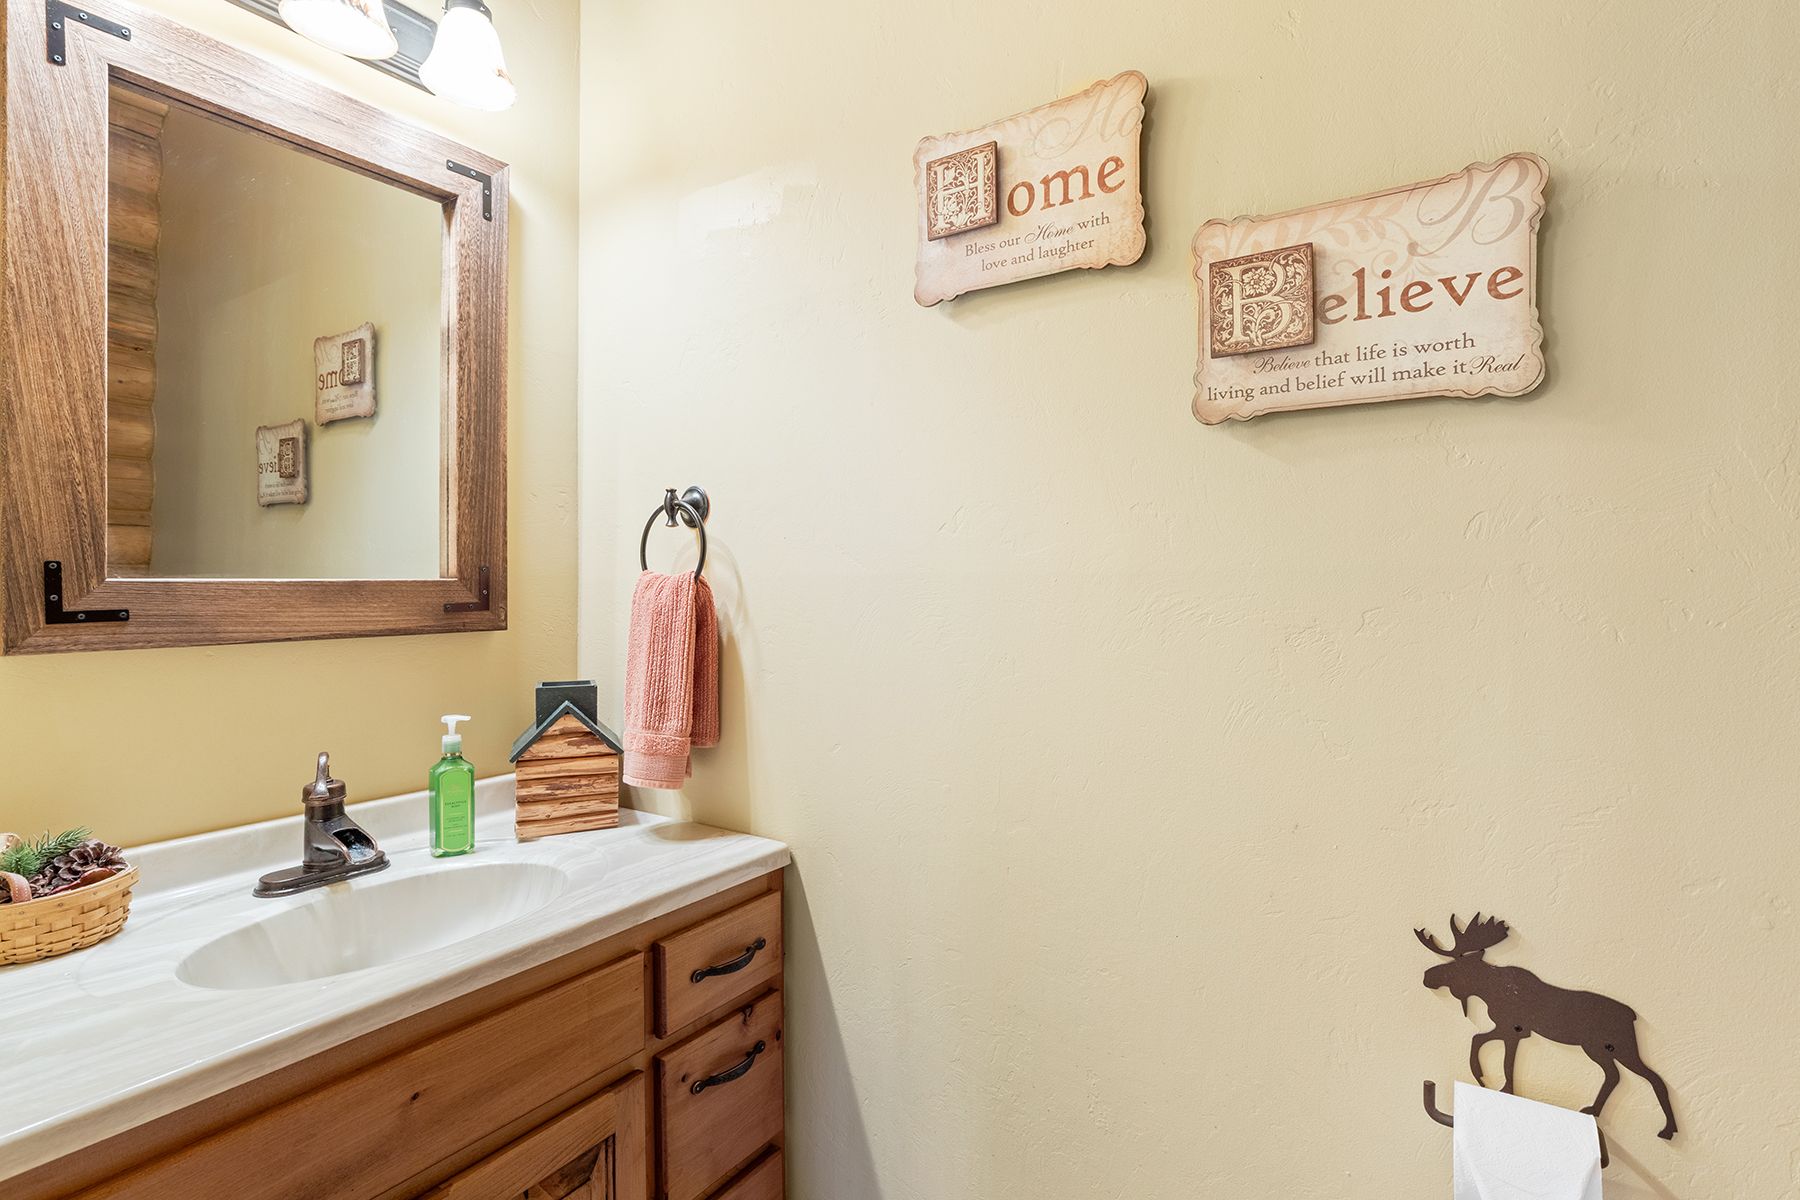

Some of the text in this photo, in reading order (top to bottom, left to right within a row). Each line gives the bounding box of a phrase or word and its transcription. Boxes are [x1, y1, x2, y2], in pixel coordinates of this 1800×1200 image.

[929, 150, 1126, 232] Home
[964, 211, 1110, 257] Bless our Home with
[981, 237, 1095, 272] love and laughter
[1215, 260, 1524, 346] Believe
[1252, 332, 1476, 375] Believe that life is worth
[1207, 354, 1526, 402] living and belief will make it Real
